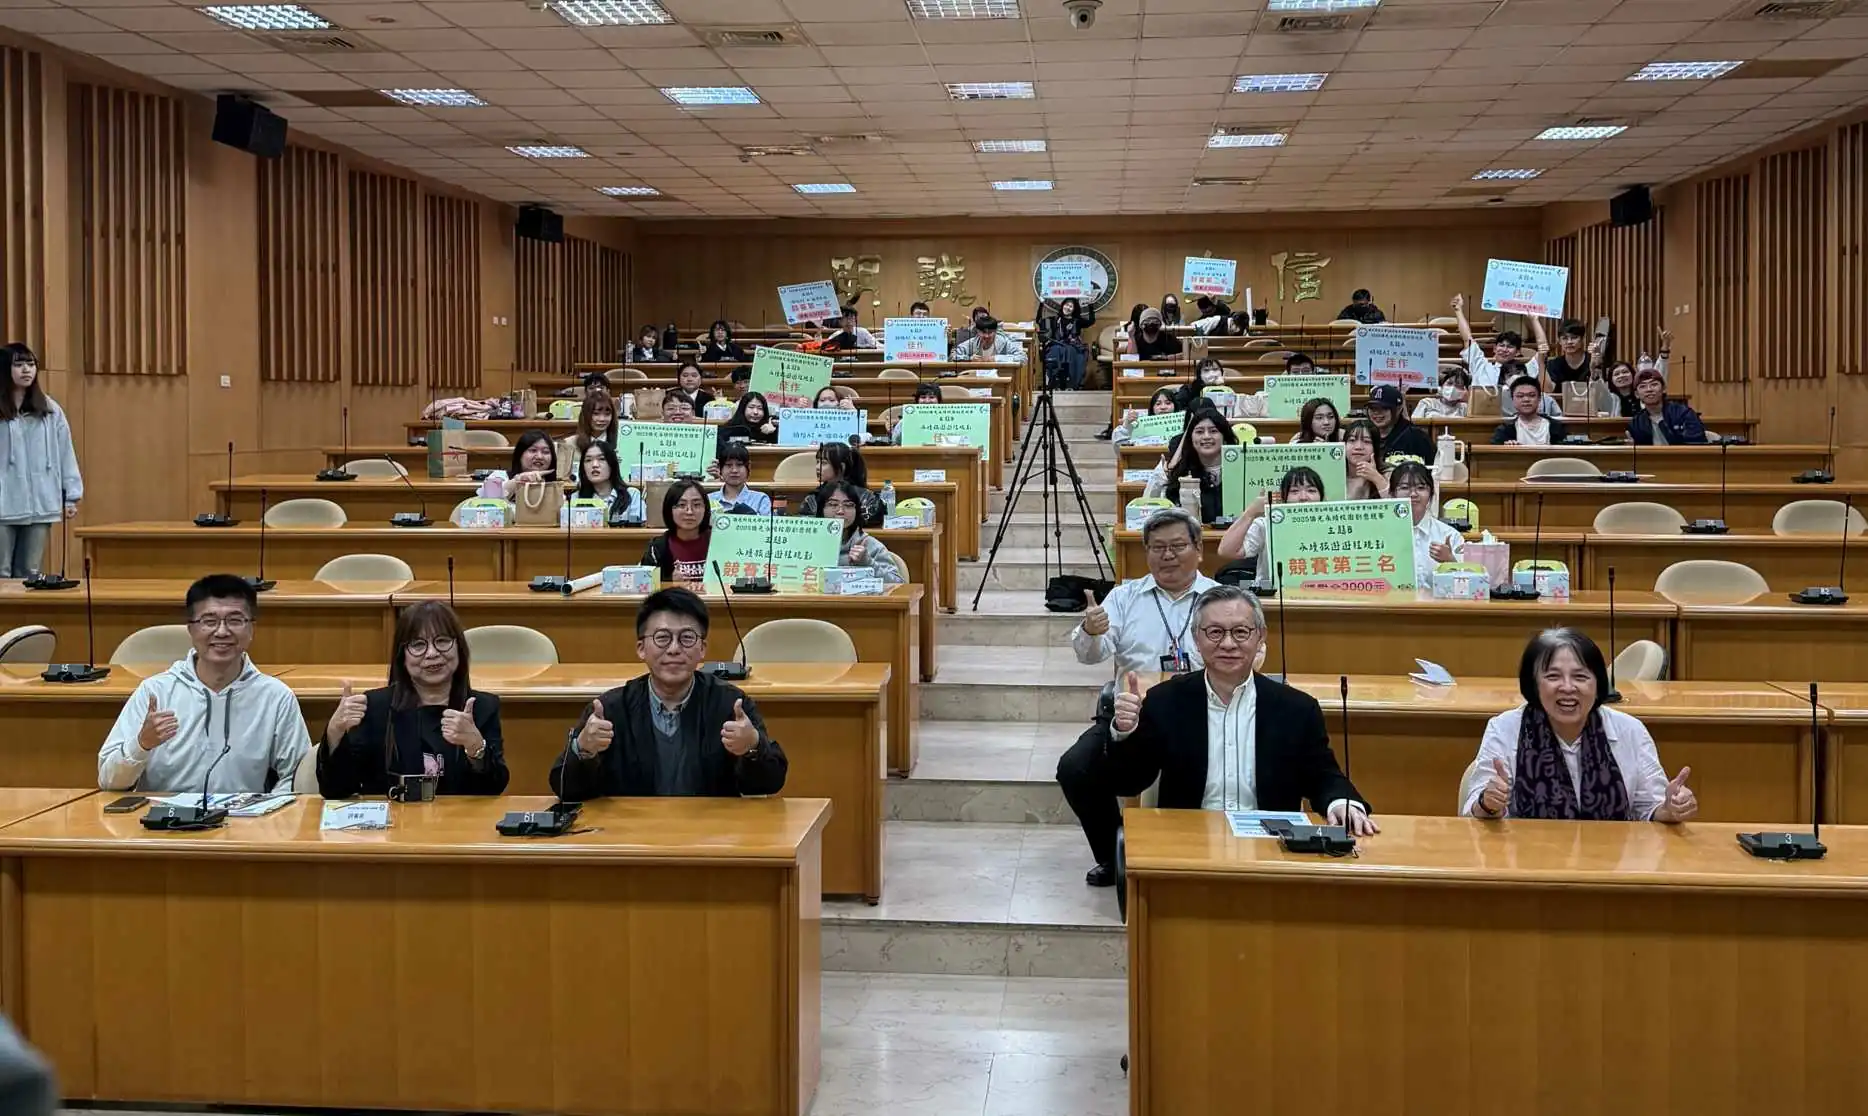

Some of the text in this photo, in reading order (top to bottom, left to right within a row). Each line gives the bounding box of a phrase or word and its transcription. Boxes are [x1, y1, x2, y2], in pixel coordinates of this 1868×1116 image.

[1271, 252, 1331, 302] 信
[1386, 357, 1409, 369] 佳作
[1287, 554, 1396, 576] 競賽第三名
[168, 807, 175, 817] 6
[524, 812, 535, 822] 61
[1316, 827, 1322, 836] 4
[1784, 833, 1792, 844] 3
